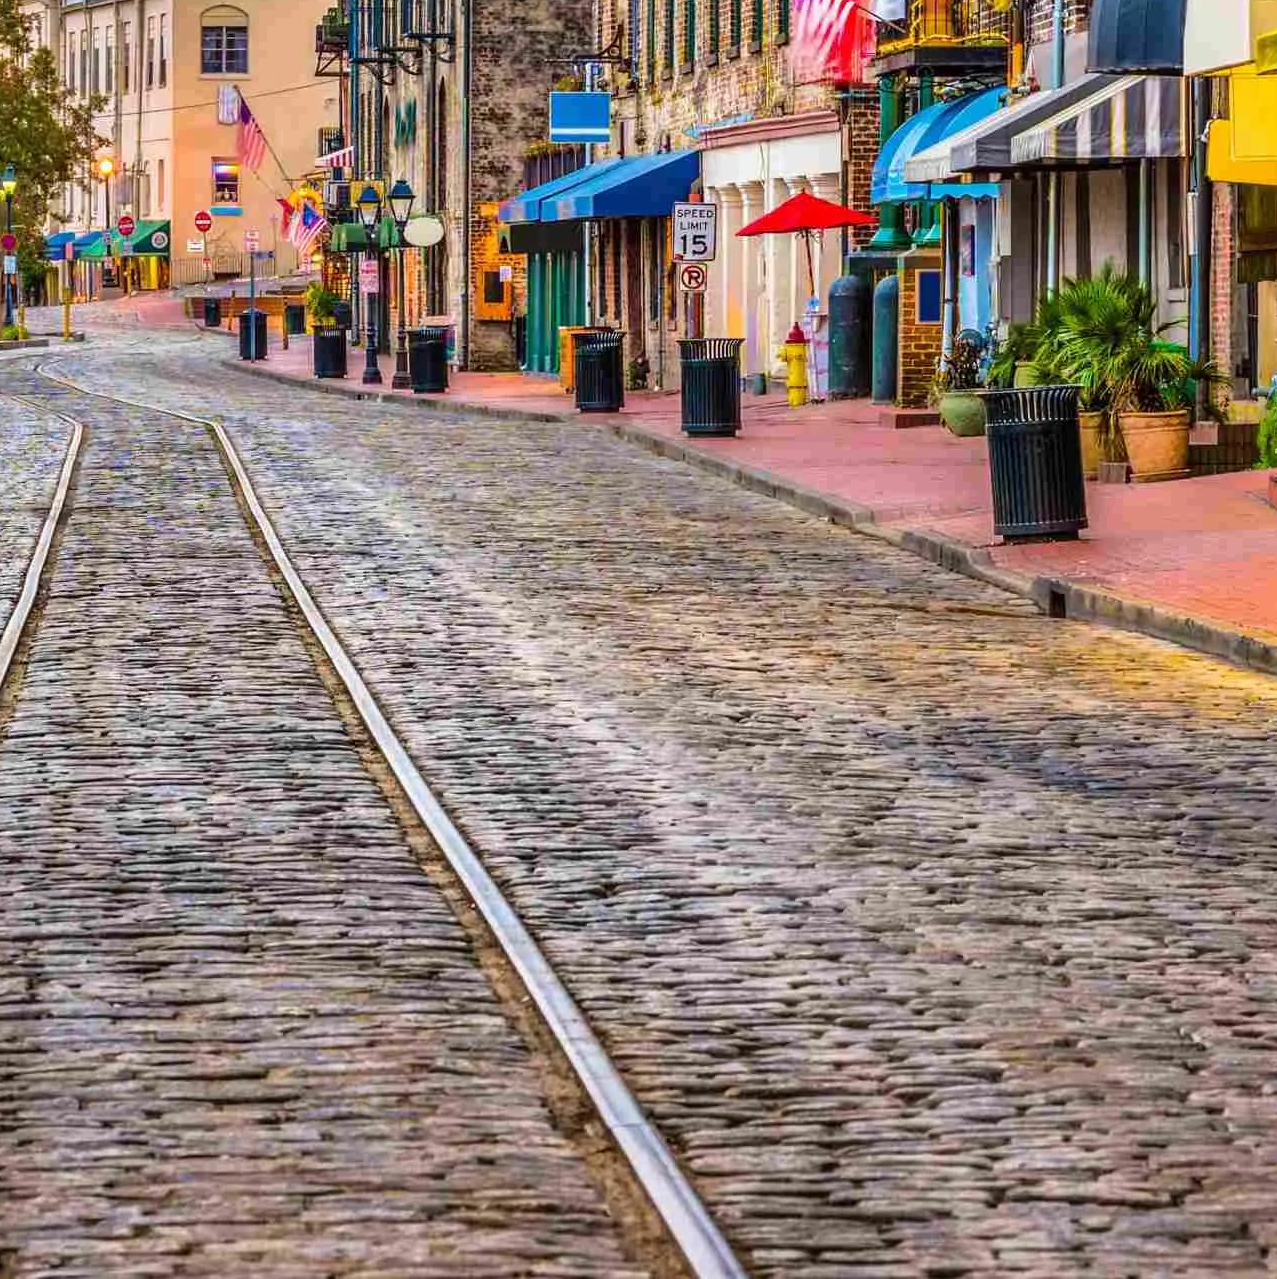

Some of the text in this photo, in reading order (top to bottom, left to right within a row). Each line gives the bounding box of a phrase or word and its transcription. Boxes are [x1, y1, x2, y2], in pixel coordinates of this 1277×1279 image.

[677, 209, 715, 219] SPEED
[680, 222, 708, 231] LIMIT
[680, 234, 708, 255] 15
